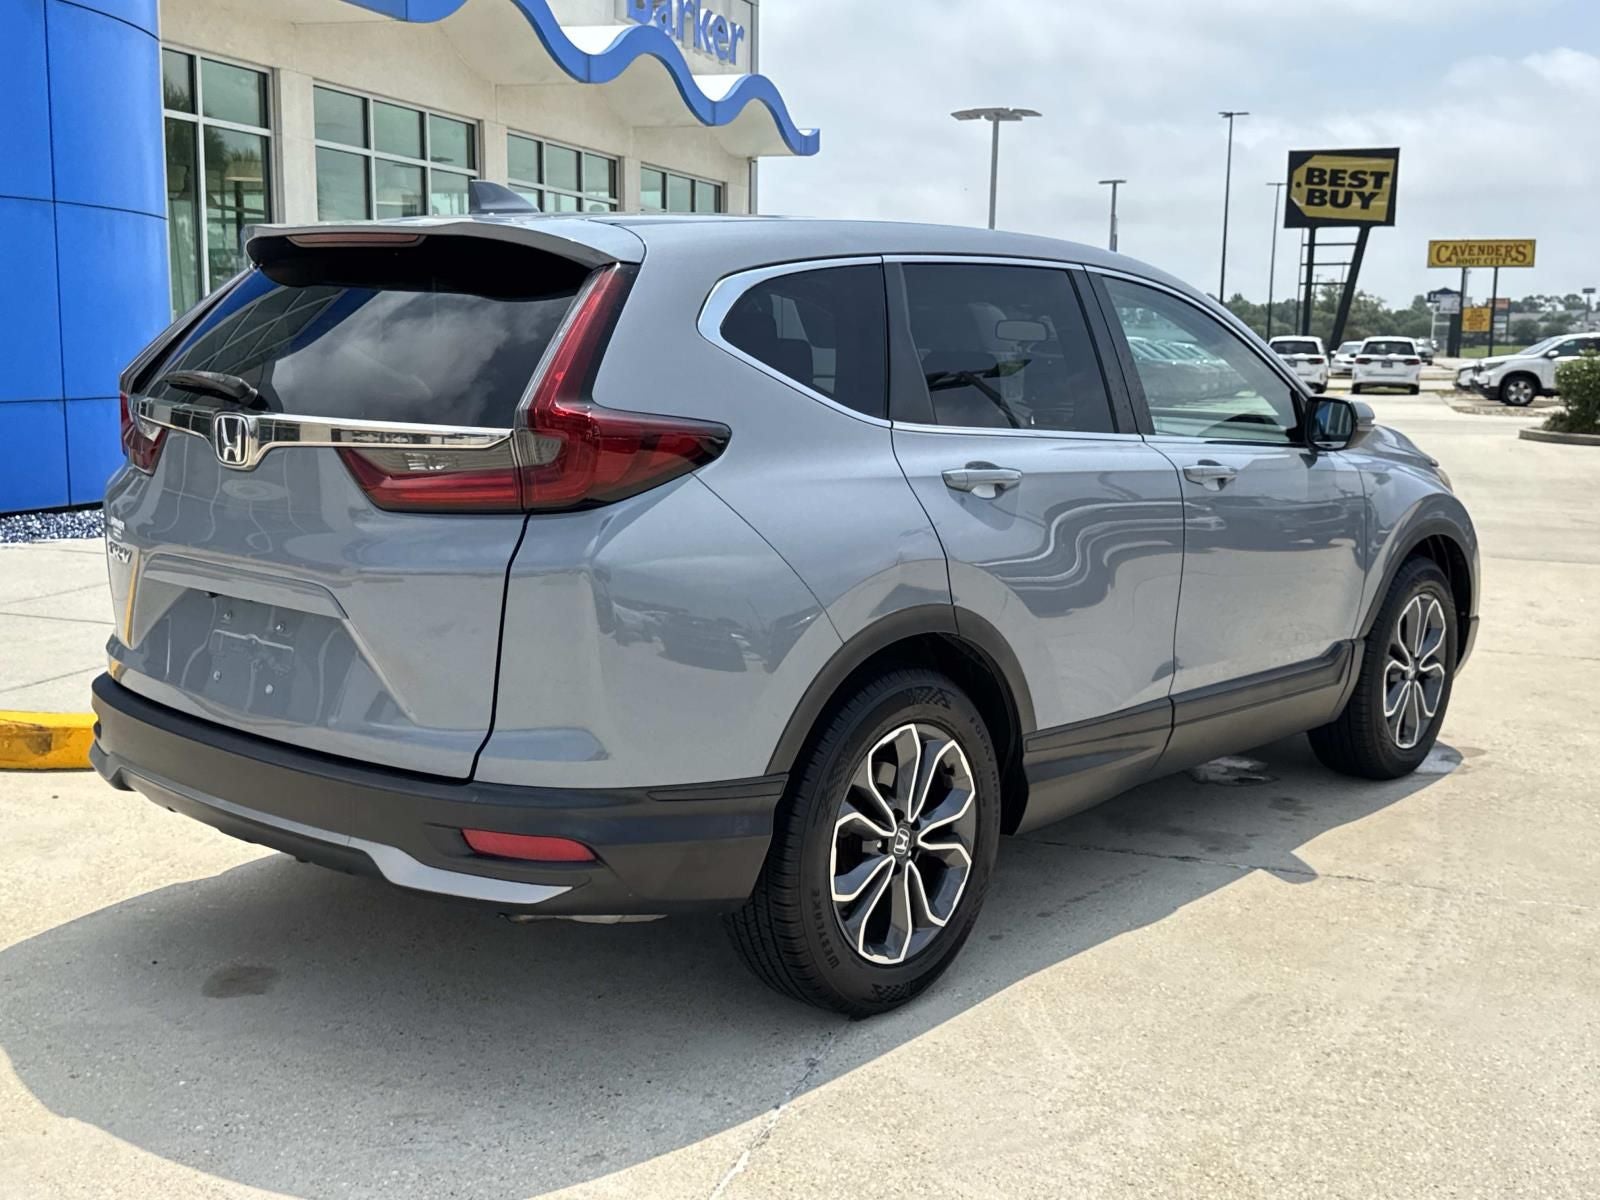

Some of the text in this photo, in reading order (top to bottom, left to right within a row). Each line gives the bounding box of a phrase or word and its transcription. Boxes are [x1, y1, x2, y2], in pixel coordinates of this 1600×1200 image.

[1304, 167, 1390, 189] BEST
[1305, 188, 1380, 210] BUY
[1436, 243, 1527, 264] CAVENDER'S
